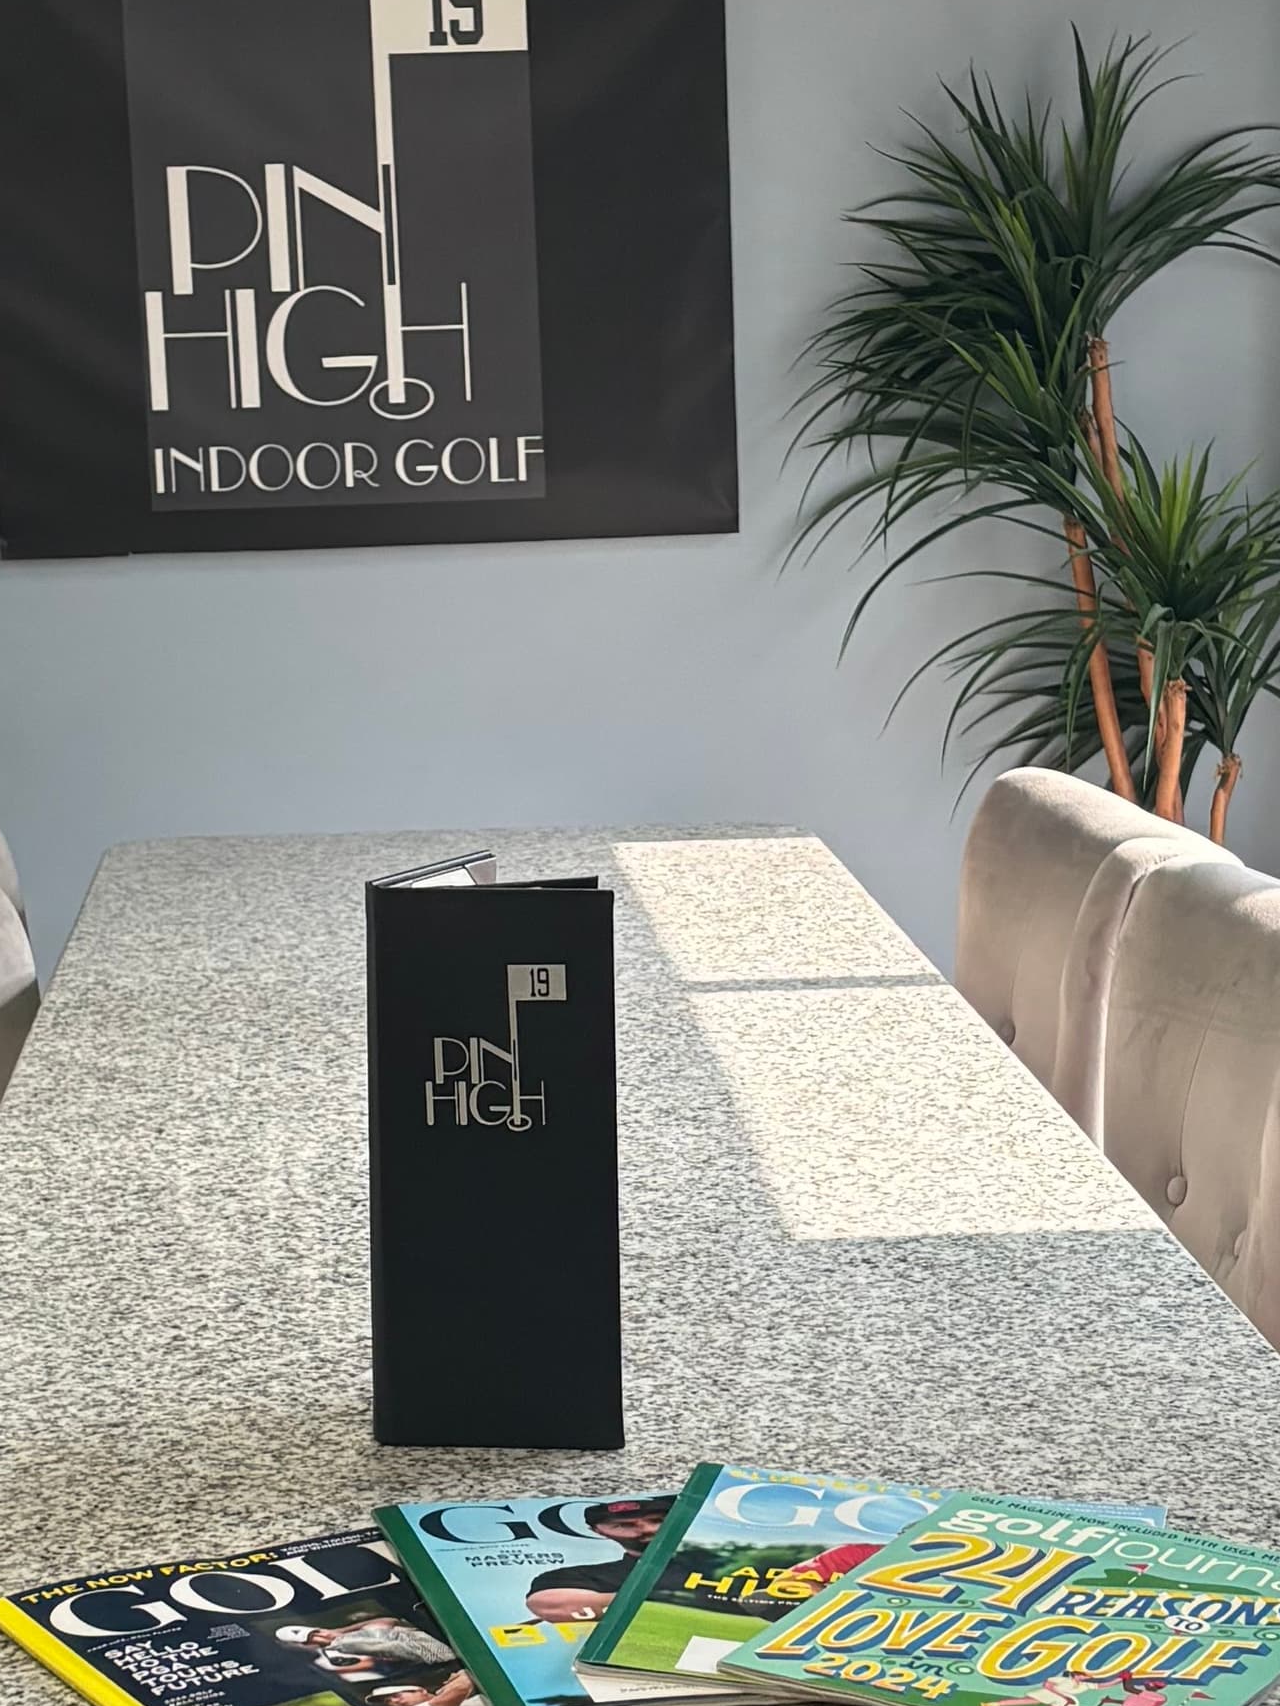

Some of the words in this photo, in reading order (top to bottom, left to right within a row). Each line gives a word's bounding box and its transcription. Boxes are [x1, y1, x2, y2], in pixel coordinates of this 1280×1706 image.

[166, 162, 399, 295] PIN
[144, 282, 472, 412] HIGH
[153, 441, 380, 494] INDOOR
[394, 435, 545, 486] GOLF
[529, 968, 550, 997] 19
[433, 1036, 520, 1084] PIN
[425, 1079, 546, 1127] HIGH
[971, 1495, 1004, 1506] GOLF
[1008, 1501, 1072, 1520] MAGAZINE
[1077, 1515, 1111, 1527] NOW
[1114, 1522, 1179, 1540] INCLUDED
[1183, 1535, 1218, 1549] WITH
[1222, 1545, 1256, 1558] USGA
[465, 1553, 564, 1562] MASTERS
[471, 1558, 565, 1568] PREVIEW
[21, 1582, 84, 1605] THE
[86, 1568, 154, 1592] NOW
[159, 1550, 279, 1581] FACTOR:
[856, 1532, 1097, 1616] 24
[754, 1589, 1016, 1660] LOVE
[977, 1615, 1273, 1688] GOLF
[1174, 1616, 1203, 1632] TO
[104, 1640, 152, 1659] SAY
[114, 1641, 199, 1666] HELLO
[122, 1659, 160, 1674] TO
[161, 1646, 219, 1662] THE
[132, 1662, 190, 1681] PGA
[140, 1660, 240, 1687] TOUR'S
[151, 1664, 260, 1696] FUTURE
[802, 1653, 959, 1700] 2024
[902, 1656, 943, 1676] in
